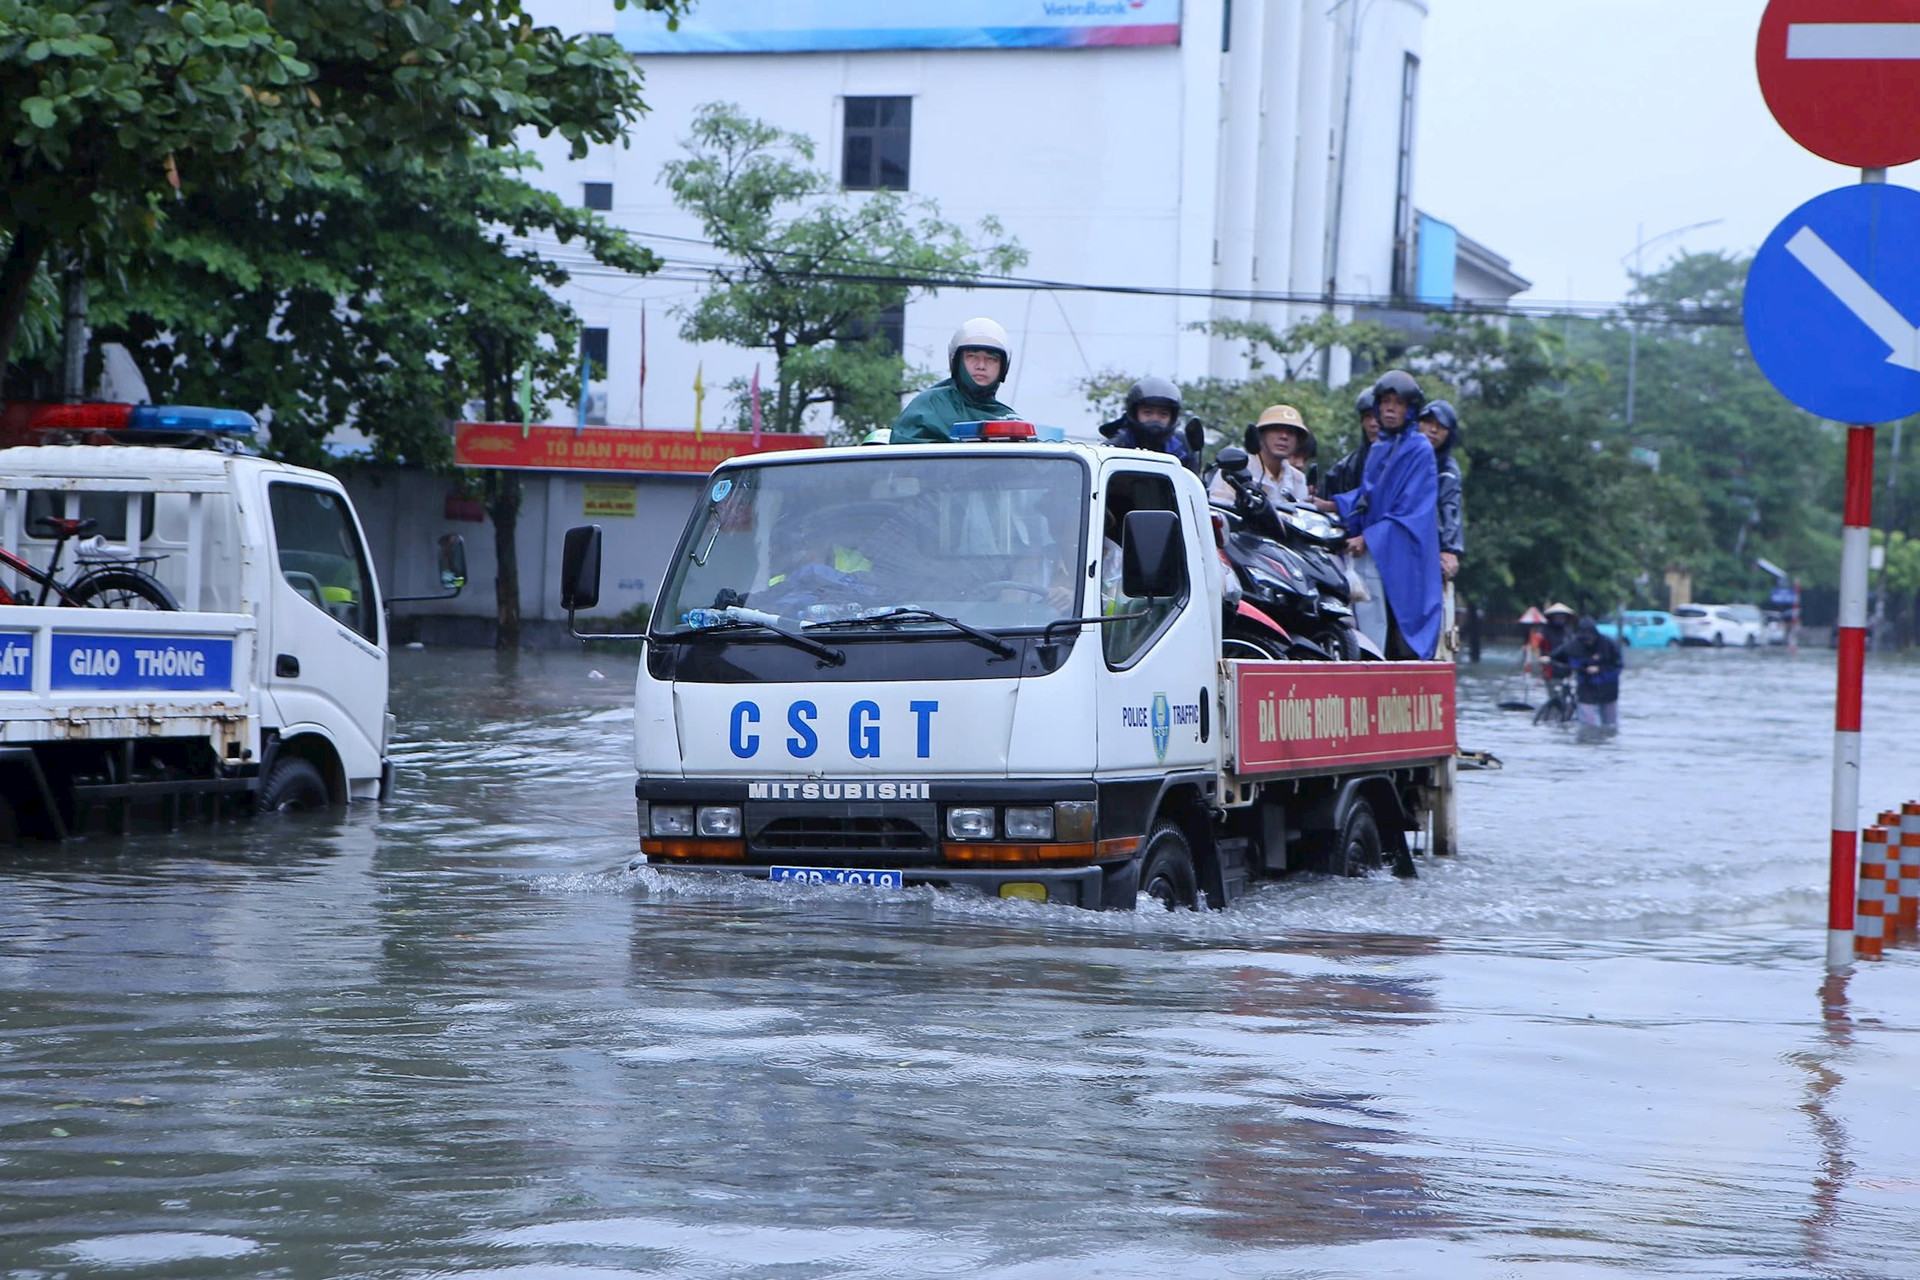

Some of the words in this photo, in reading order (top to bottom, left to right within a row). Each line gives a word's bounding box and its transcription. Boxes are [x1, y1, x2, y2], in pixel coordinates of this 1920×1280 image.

[573, 439, 612, 457] DÂN
[616, 440, 654, 460] PHỐ
[0, 642, 30, 675] ÁT
[69, 649, 120, 676] GIAO
[135, 646, 205, 676] THÔNG
[1122, 707, 1148, 727] POLICE
[1172, 704, 1199, 725] TRAFFIC
[1259, 691, 1277, 742] ĐÃ
[1279, 683, 1312, 741] UỐNG
[1350, 696, 1369, 736] BIA
[1378, 687, 1412, 735] KHÔNG
[1413, 686, 1429, 732] LÁI
[1429, 693, 1443, 730] XE
[749, 783, 931, 800] MITSUBISHI
